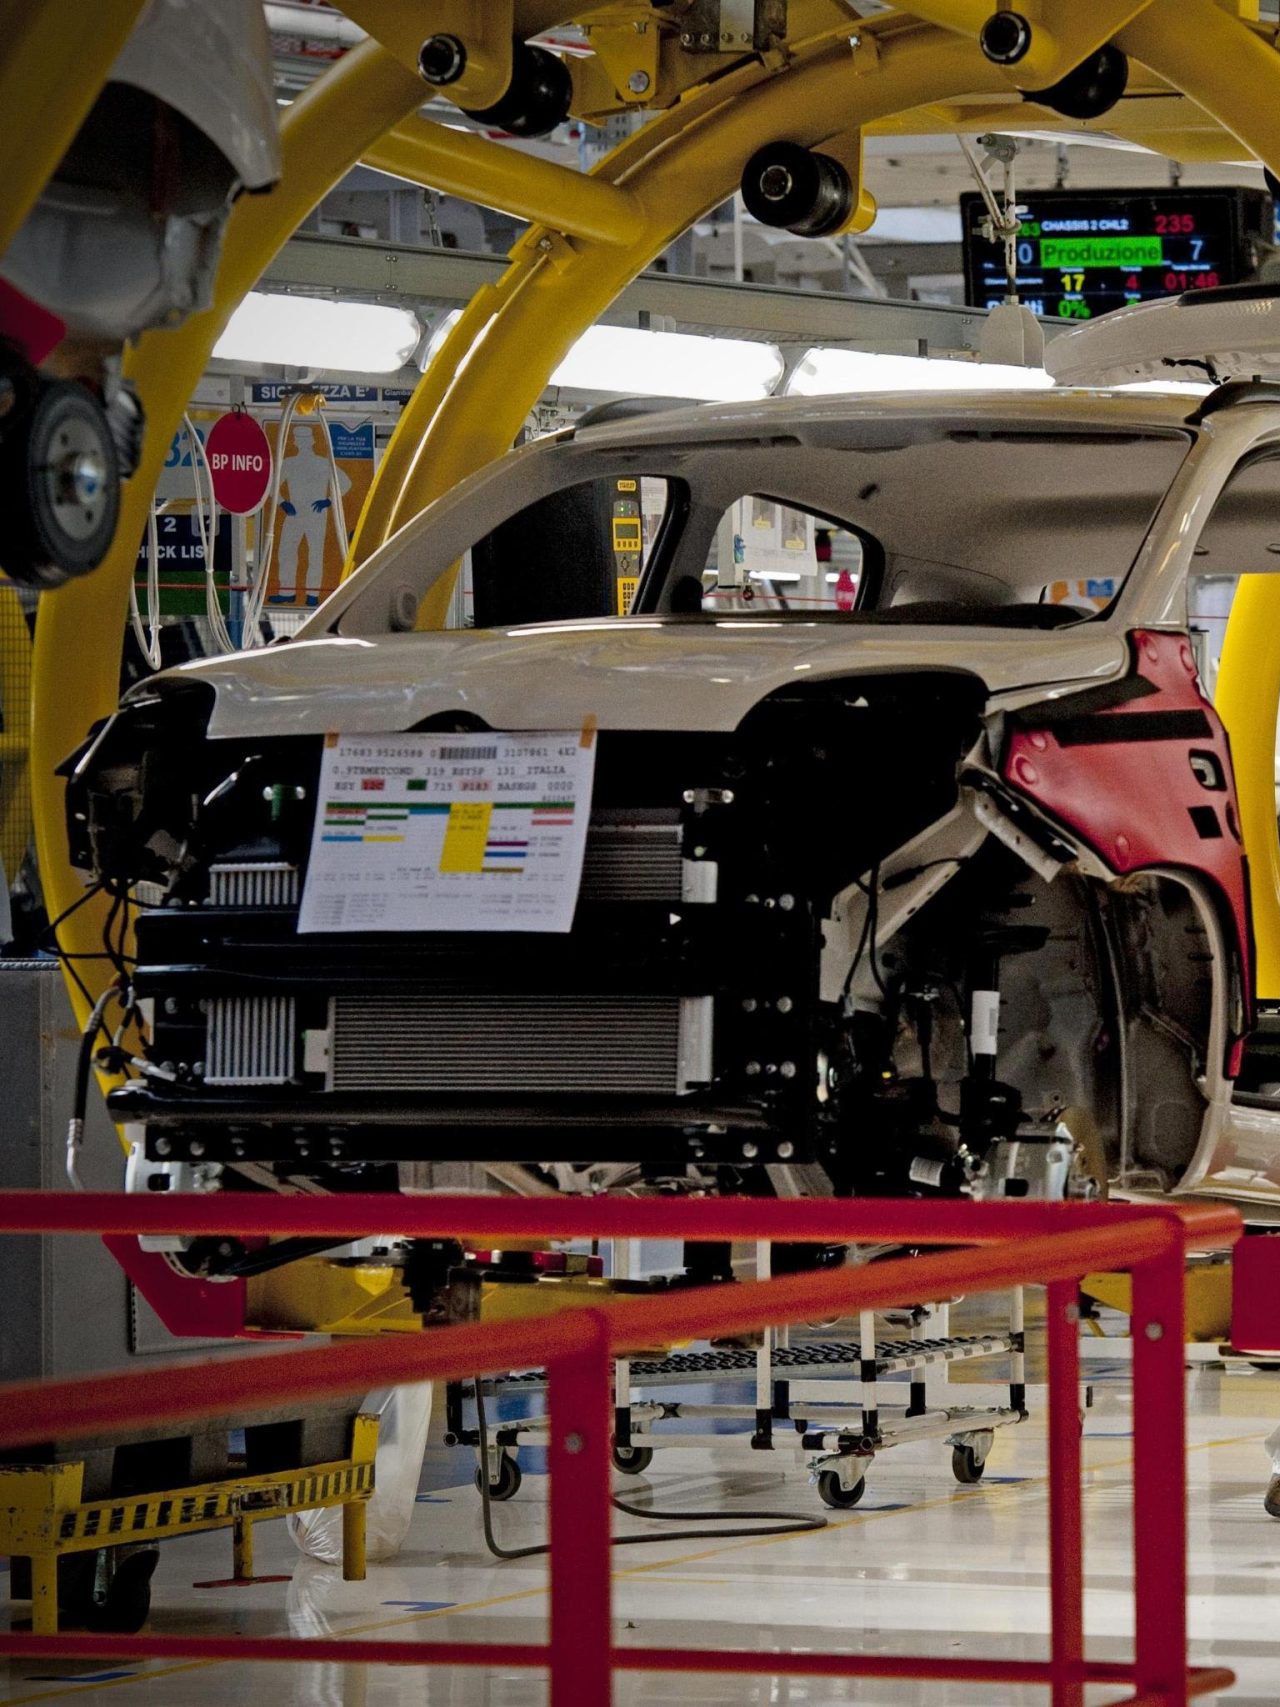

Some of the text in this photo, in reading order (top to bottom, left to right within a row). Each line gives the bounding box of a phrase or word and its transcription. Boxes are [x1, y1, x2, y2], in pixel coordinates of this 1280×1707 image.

[1155, 214, 1194, 233] 235
[1043, 244, 1160, 263] Produzione
[1189, 240, 1203, 261] 7
[1060, 273, 1086, 292] 17
[1125, 274, 1138, 290] 4
[212, 453, 263, 472] BP INFO
[164, 517, 177, 533] 2
[526, 765, 566, 775] ITALIA
